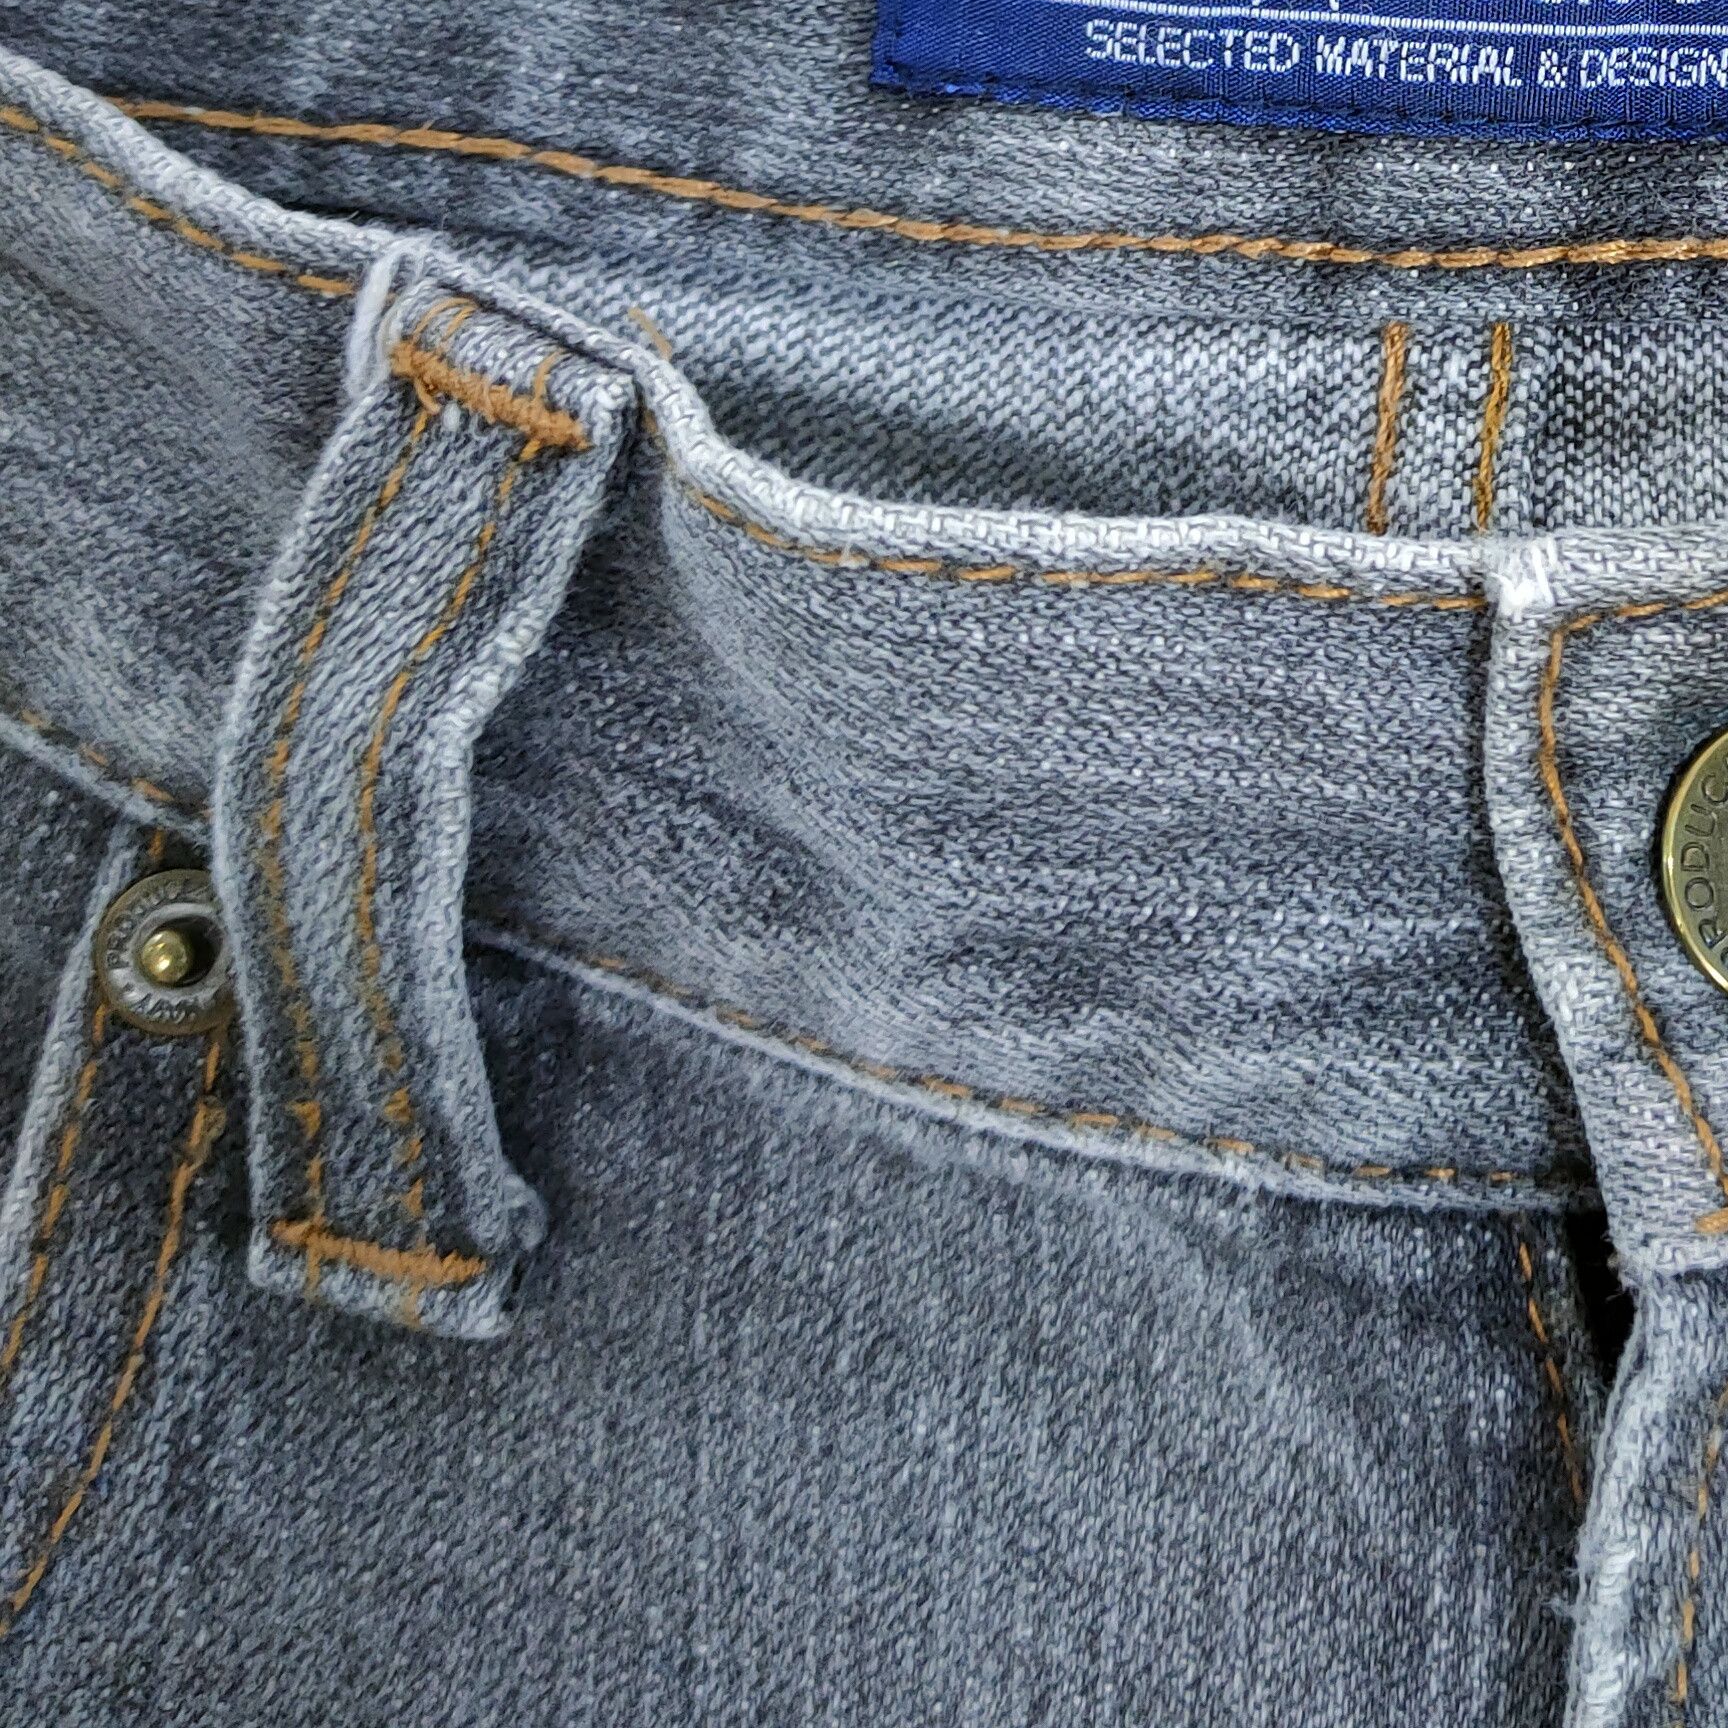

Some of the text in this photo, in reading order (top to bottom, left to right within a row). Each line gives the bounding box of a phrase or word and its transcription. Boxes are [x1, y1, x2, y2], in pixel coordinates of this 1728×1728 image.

[1085, 18, 1728, 89] SELECTED MATERIAL & DESIGN
